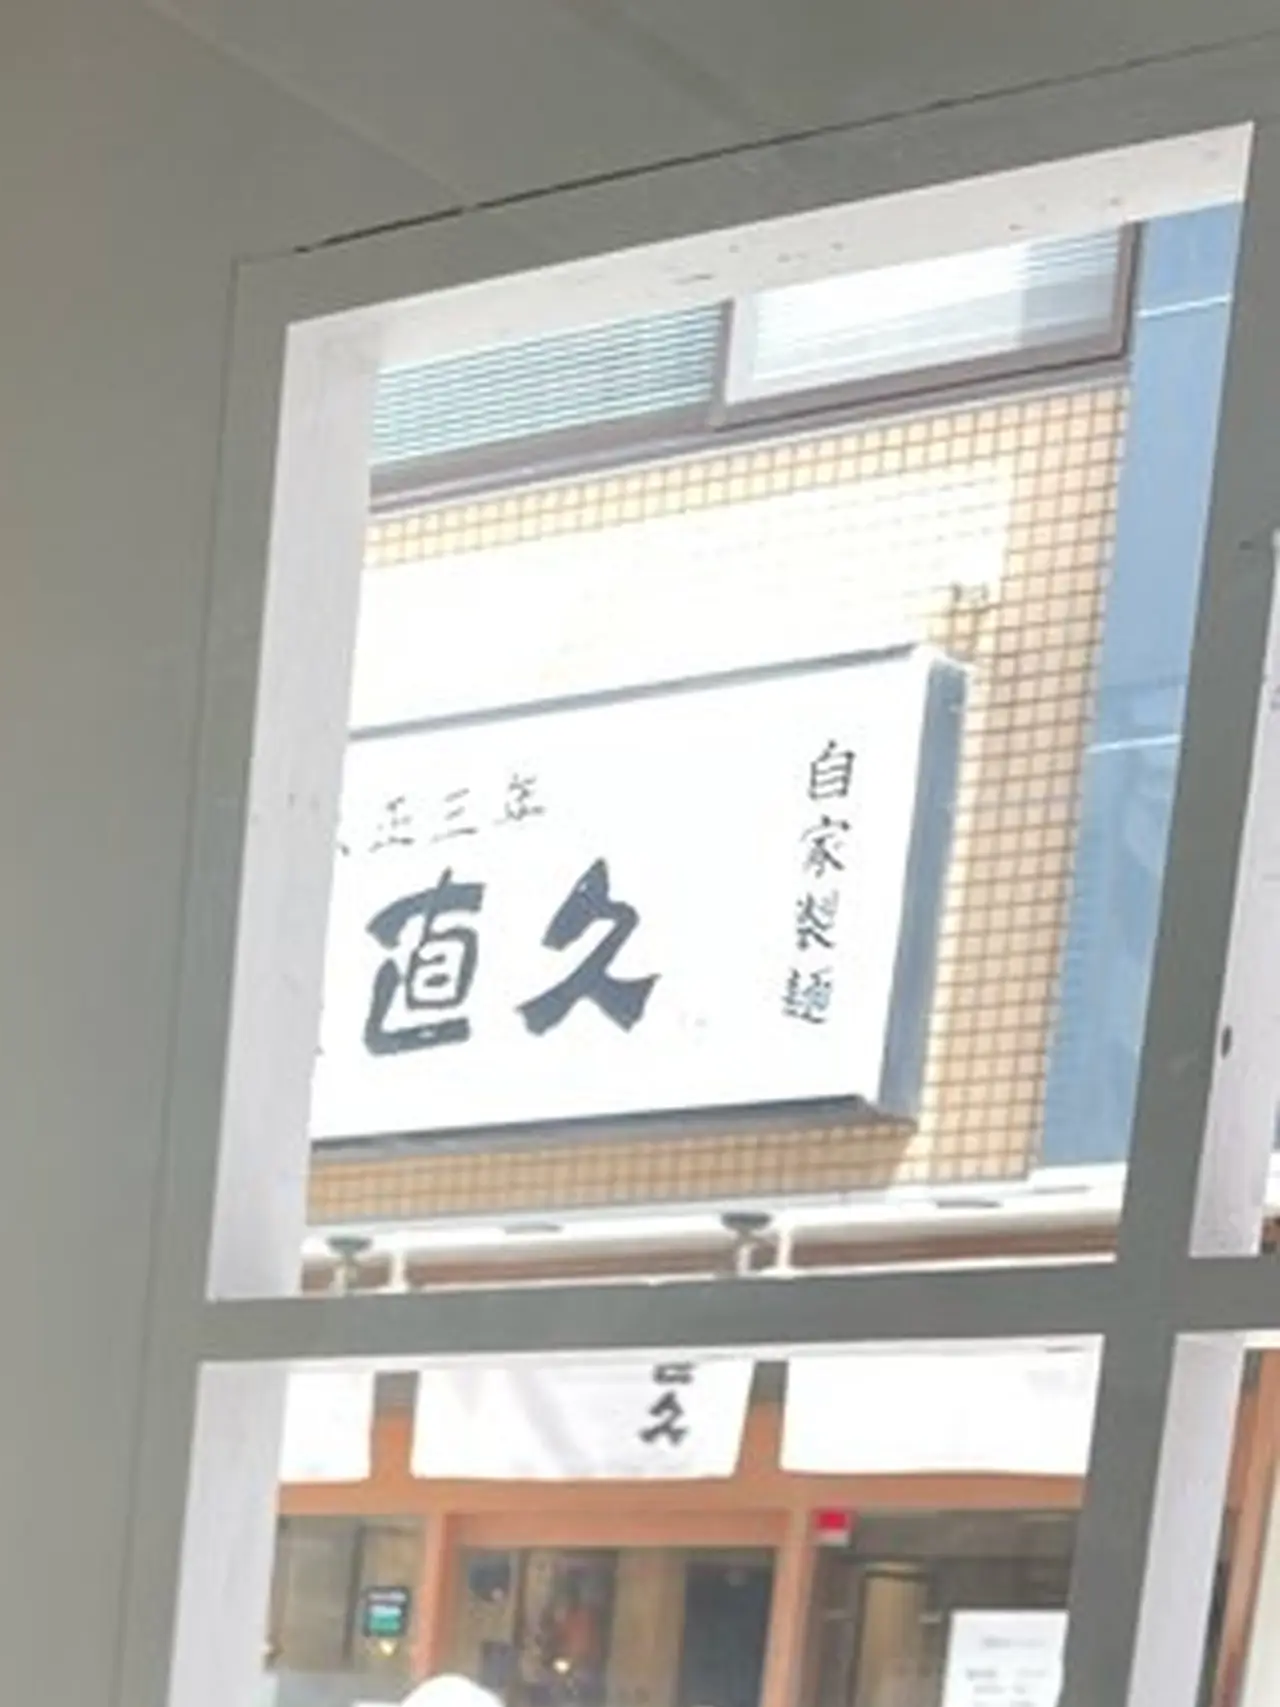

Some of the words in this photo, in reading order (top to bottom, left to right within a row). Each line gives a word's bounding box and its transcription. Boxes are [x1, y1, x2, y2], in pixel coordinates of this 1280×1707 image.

[338, 770, 547, 857] 正三年
[363, 856, 662, 1057] 直久
